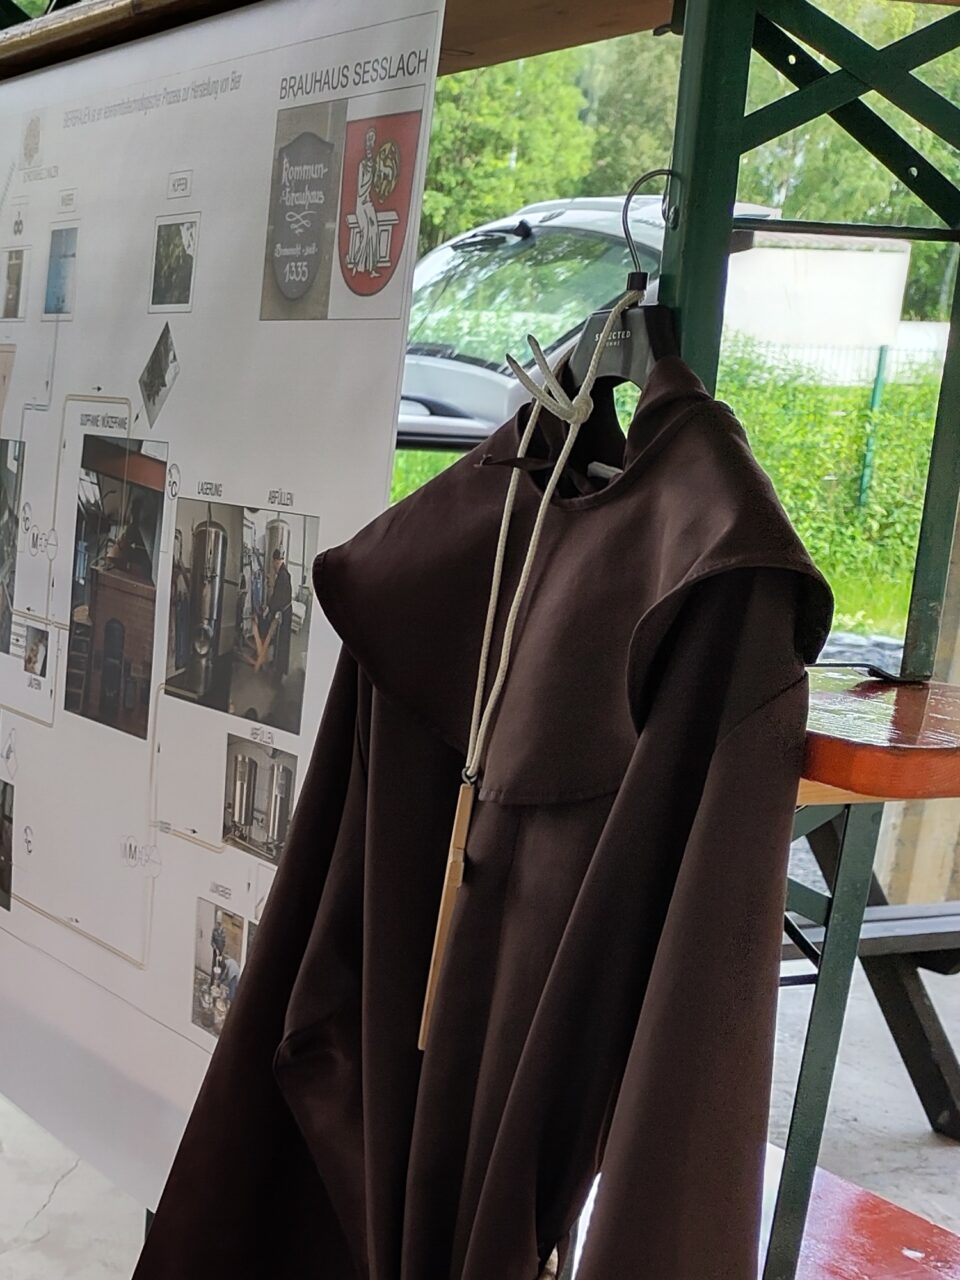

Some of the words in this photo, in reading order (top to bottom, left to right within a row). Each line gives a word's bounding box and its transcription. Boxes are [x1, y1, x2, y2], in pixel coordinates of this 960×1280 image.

[279, 64, 349, 100] BRAUHAUS
[352, 48, 429, 87] SESSLACH
[283, 260, 309, 283] 1335
